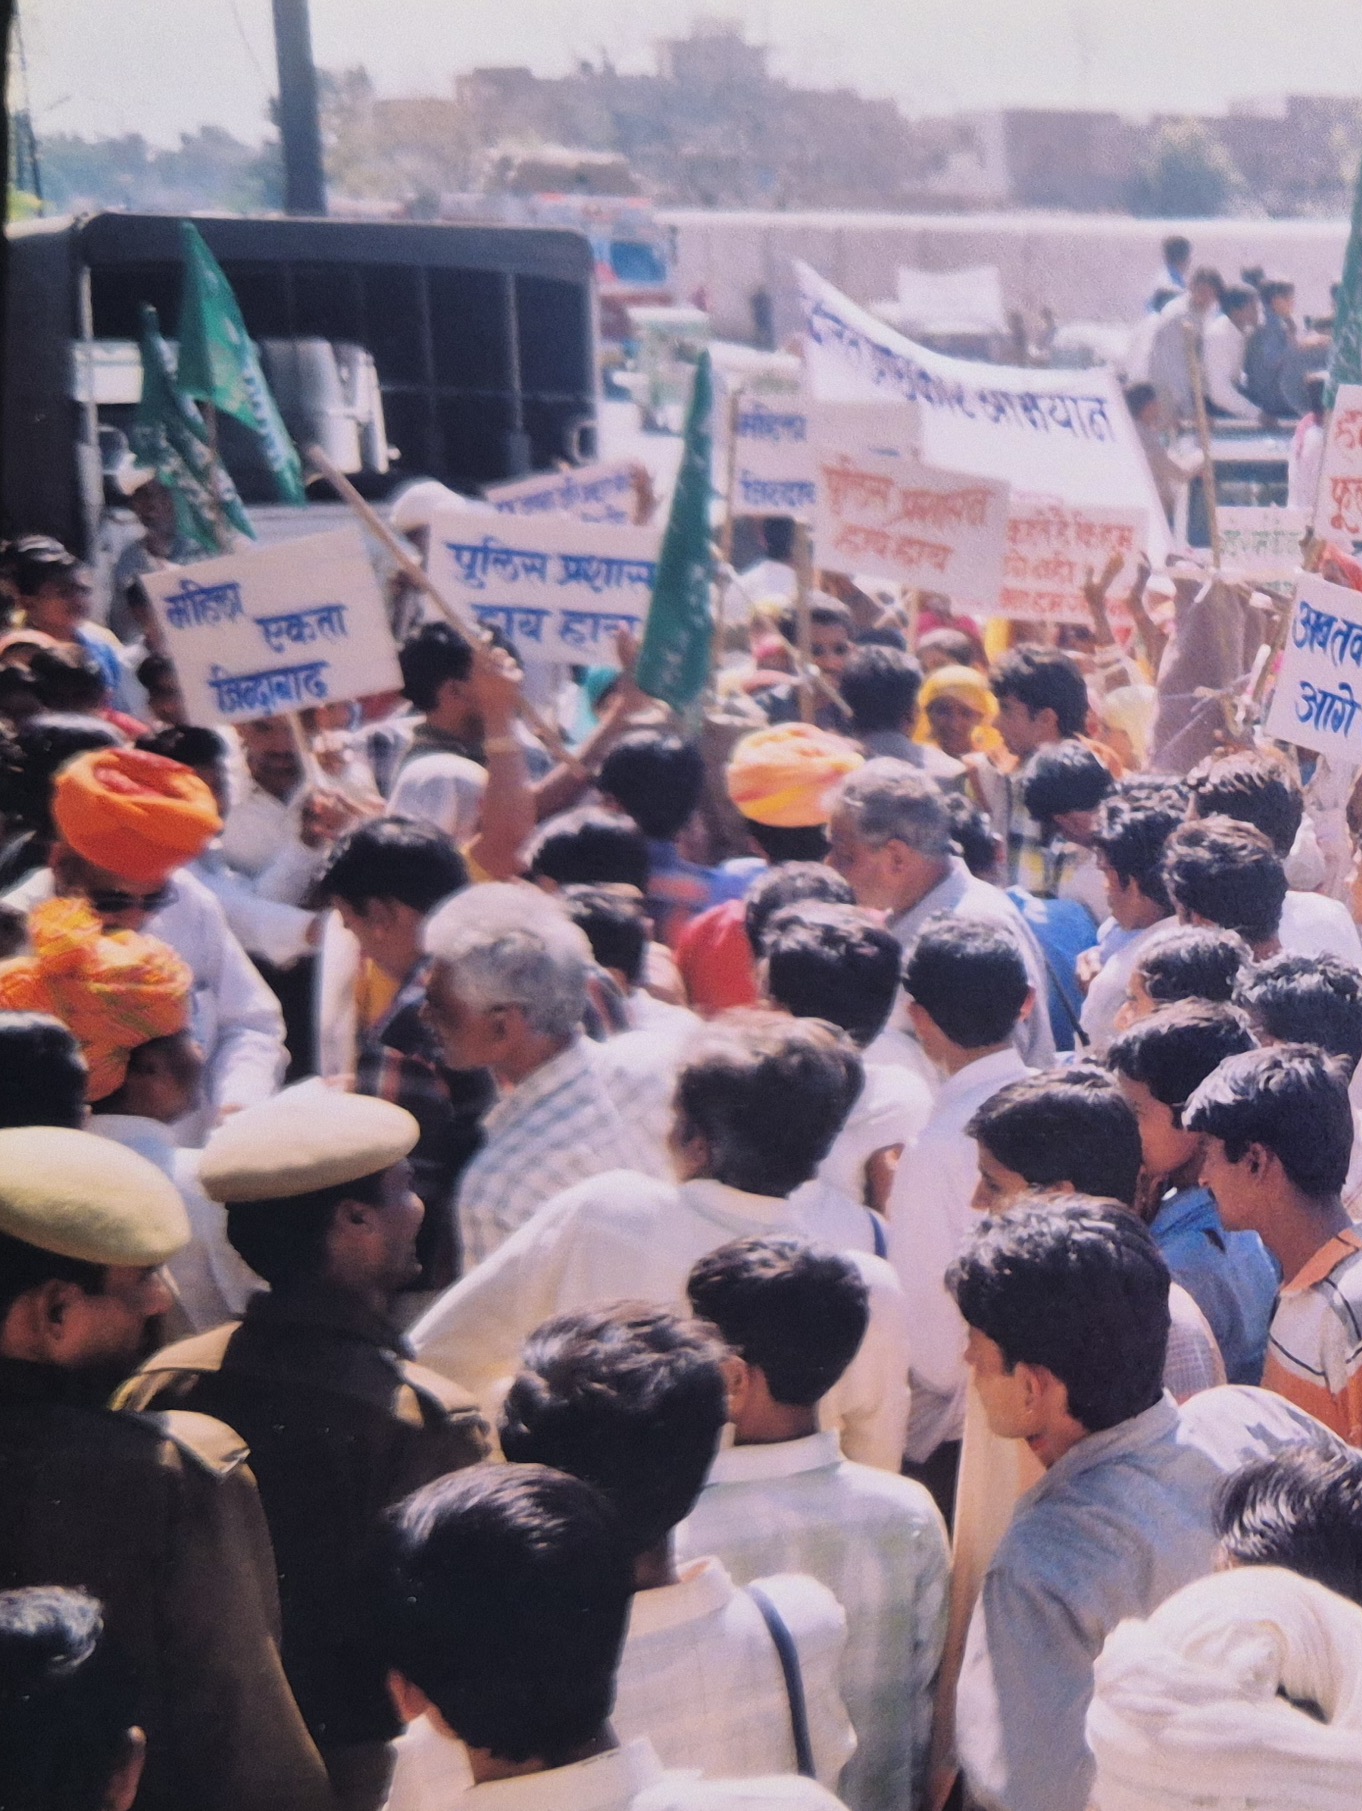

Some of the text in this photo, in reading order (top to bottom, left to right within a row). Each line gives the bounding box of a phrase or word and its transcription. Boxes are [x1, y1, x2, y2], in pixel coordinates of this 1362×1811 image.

[556, 554, 657, 593] प्रशास
[254, 605, 349, 653] एकता
[1296, 681, 1362, 738] आगे
